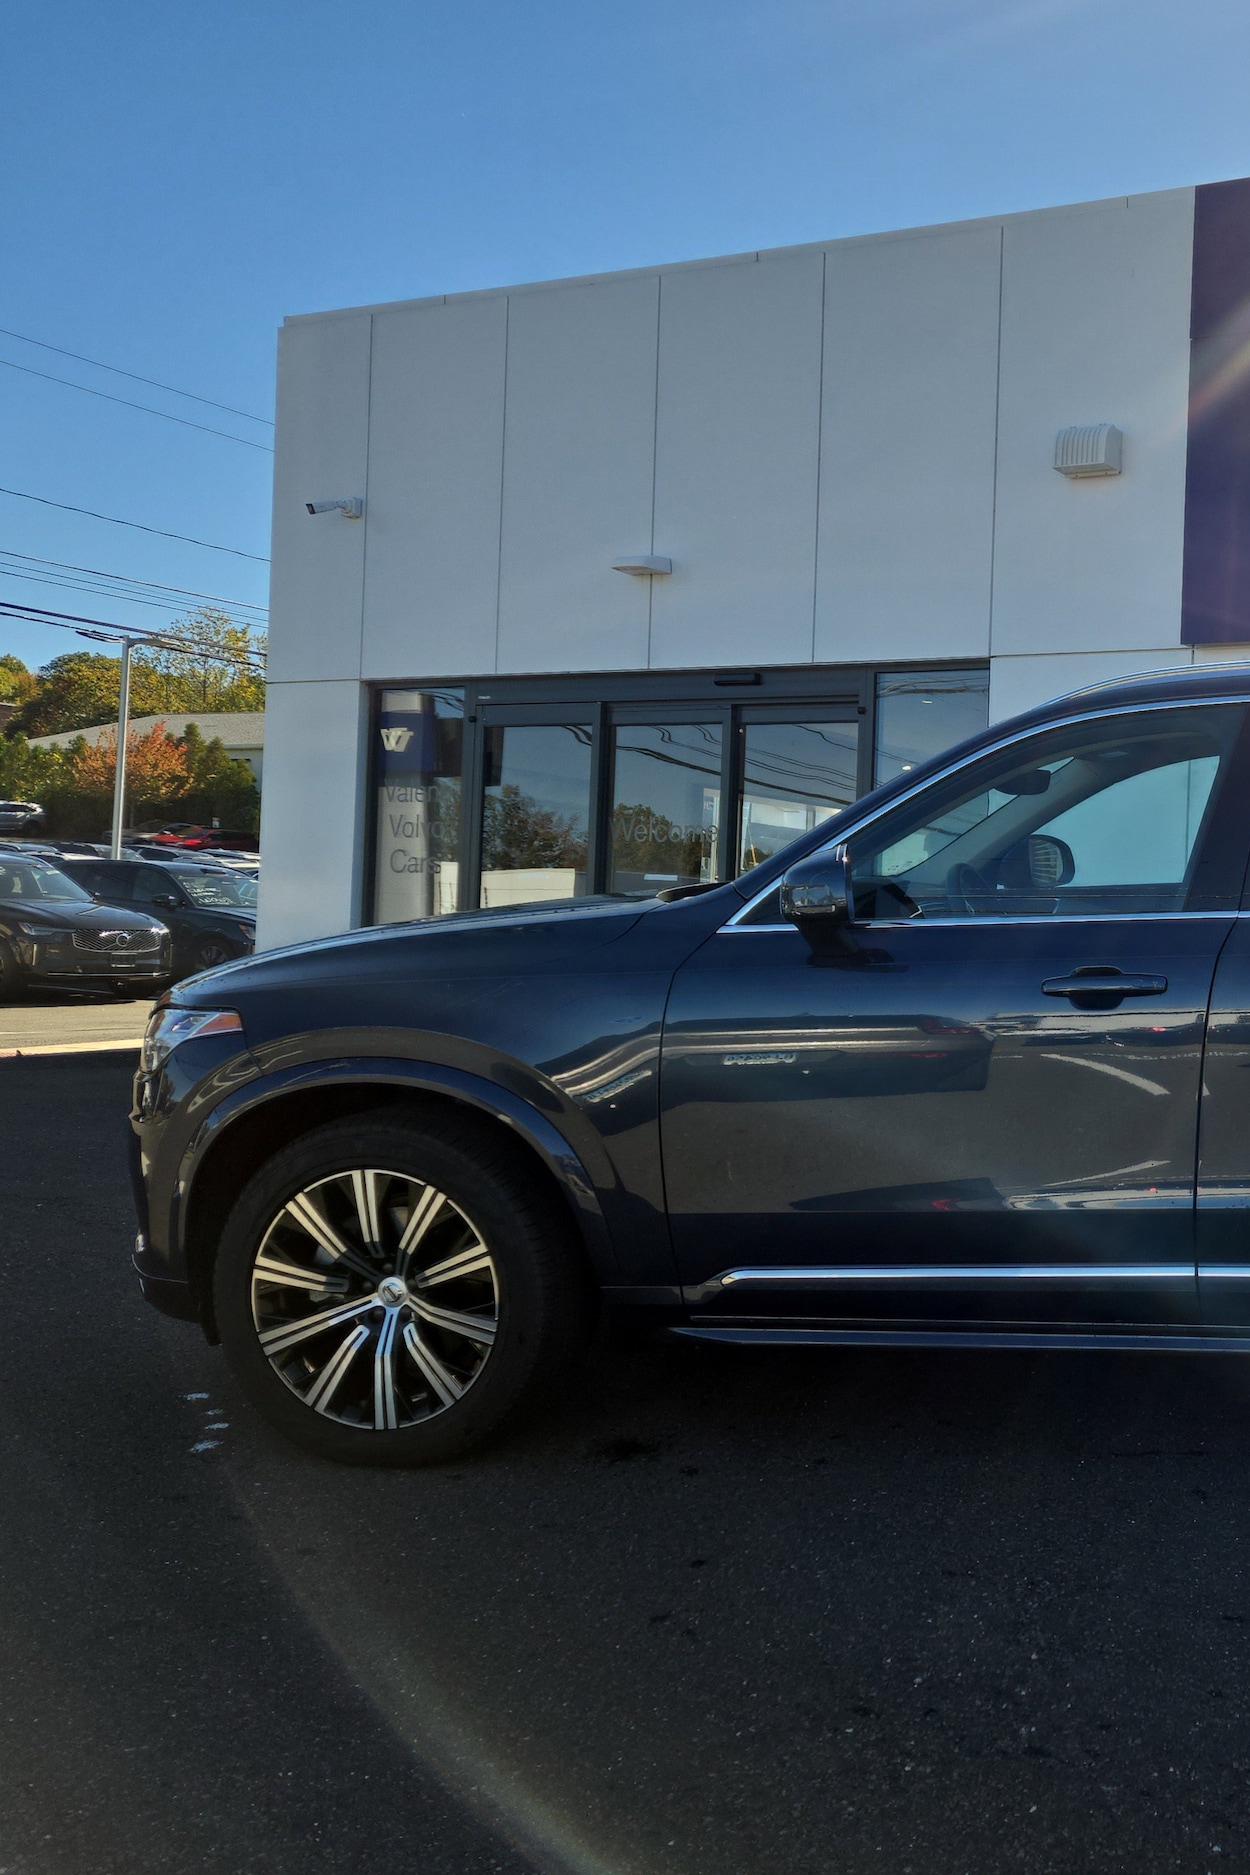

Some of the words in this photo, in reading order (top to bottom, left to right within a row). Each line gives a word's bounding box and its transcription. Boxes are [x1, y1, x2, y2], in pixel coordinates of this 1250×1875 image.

[388, 813, 445, 839] Volvo
[609, 817, 719, 843] Welcome
[389, 848, 442, 874] Cars
